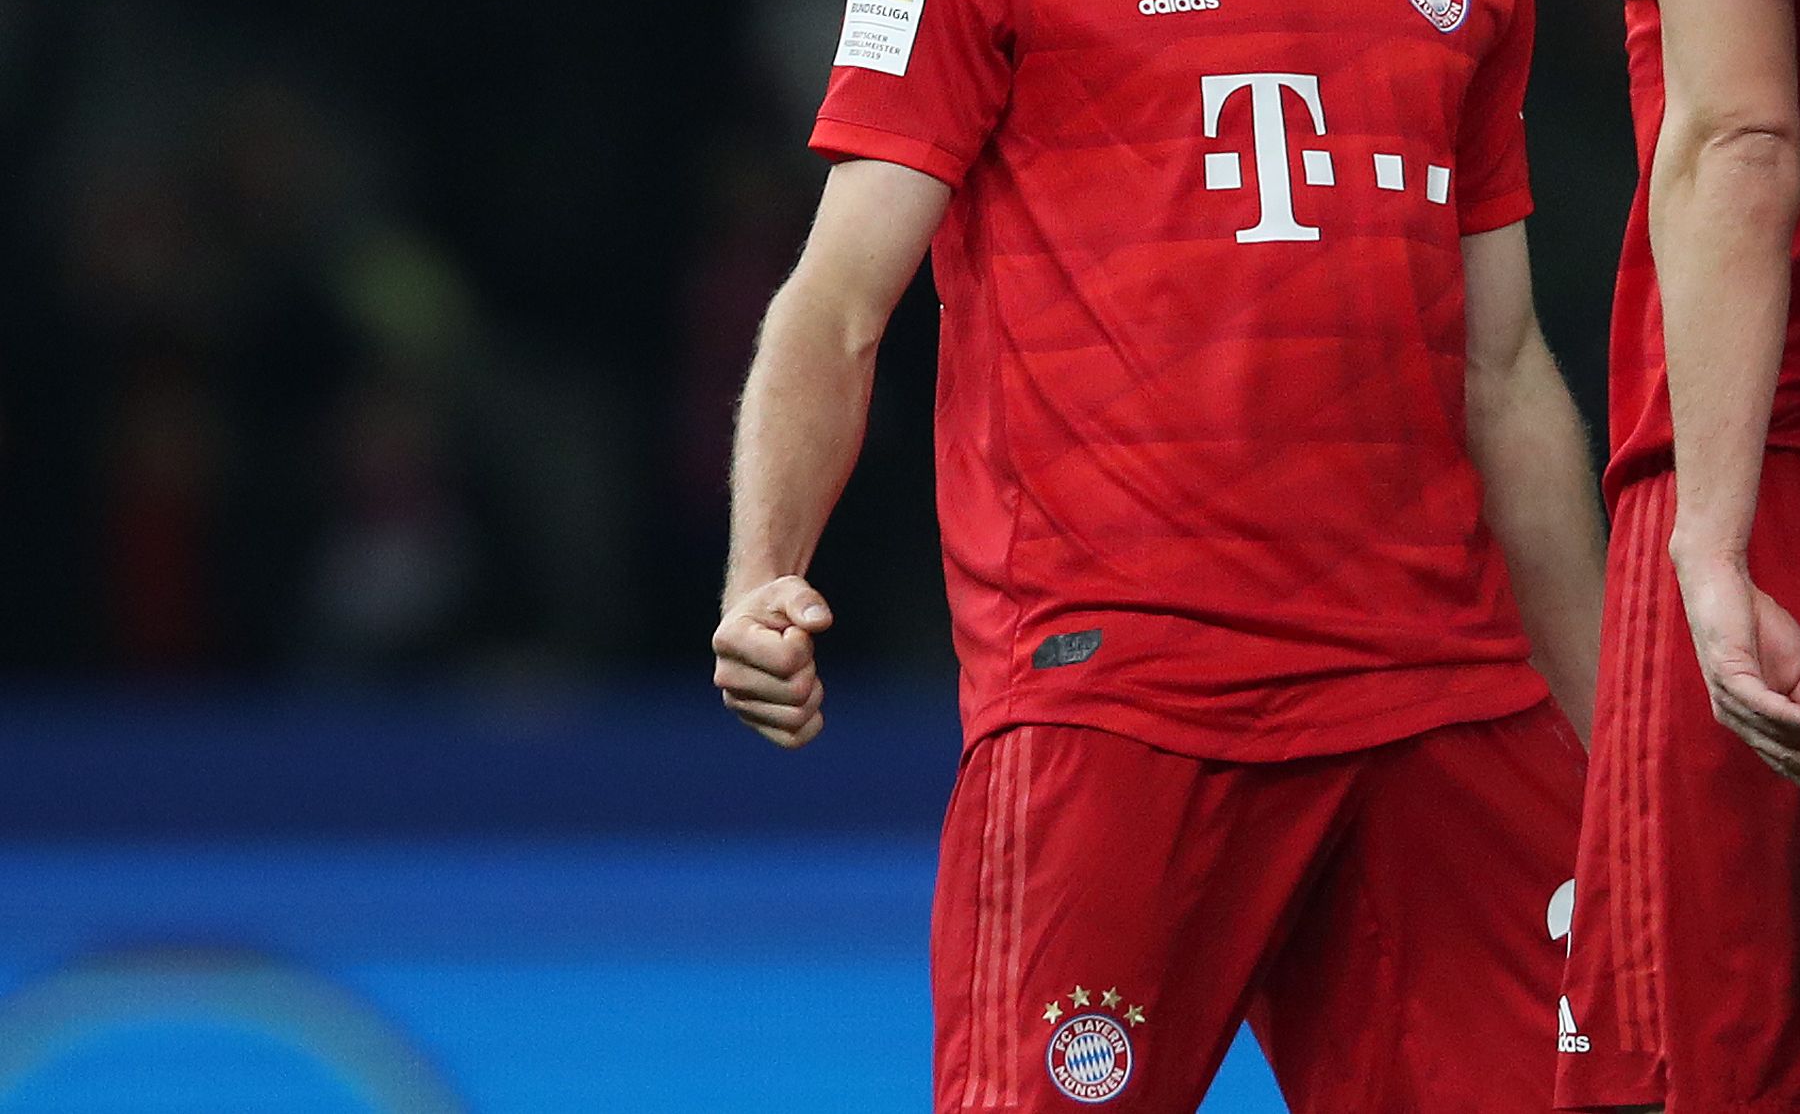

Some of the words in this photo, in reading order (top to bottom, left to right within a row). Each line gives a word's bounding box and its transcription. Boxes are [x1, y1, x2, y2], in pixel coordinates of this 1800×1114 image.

[851, 3, 909, 22] BUNDESLIGA
[1055, 1030, 1073, 1052] FC
[1073, 1019, 1126, 1054] BAYERN
